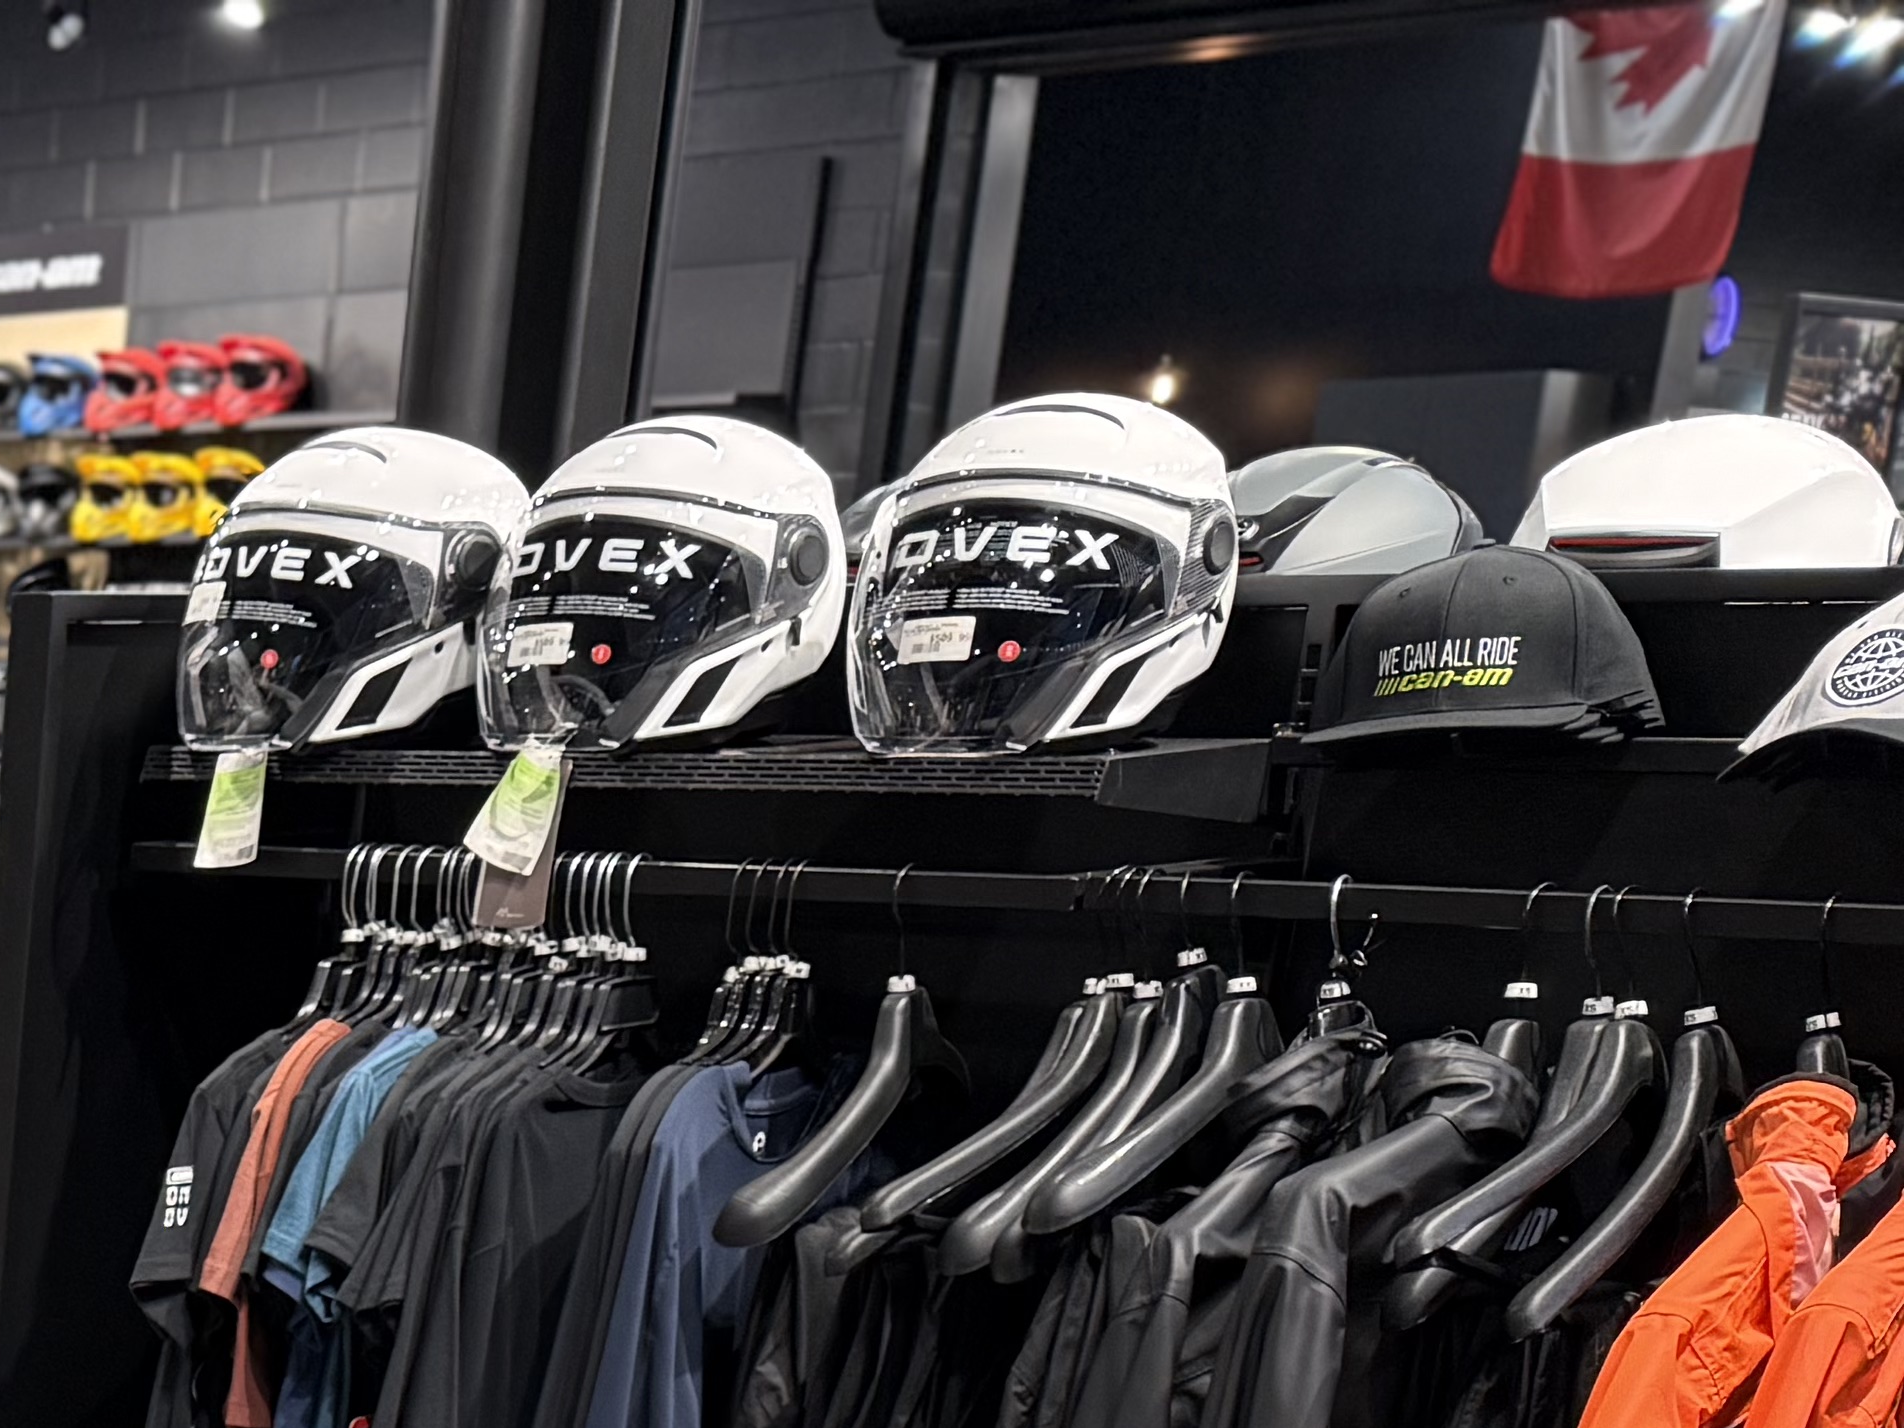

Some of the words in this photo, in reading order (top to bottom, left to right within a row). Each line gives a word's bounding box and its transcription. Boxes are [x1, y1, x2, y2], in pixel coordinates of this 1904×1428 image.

[1379, 646, 1402, 676] WE
[1403, 641, 1438, 673] CAN
[1440, 639, 1474, 667] ALL
[1477, 636, 1523, 665] RIDE
[1399, 667, 1514, 692] can-am
